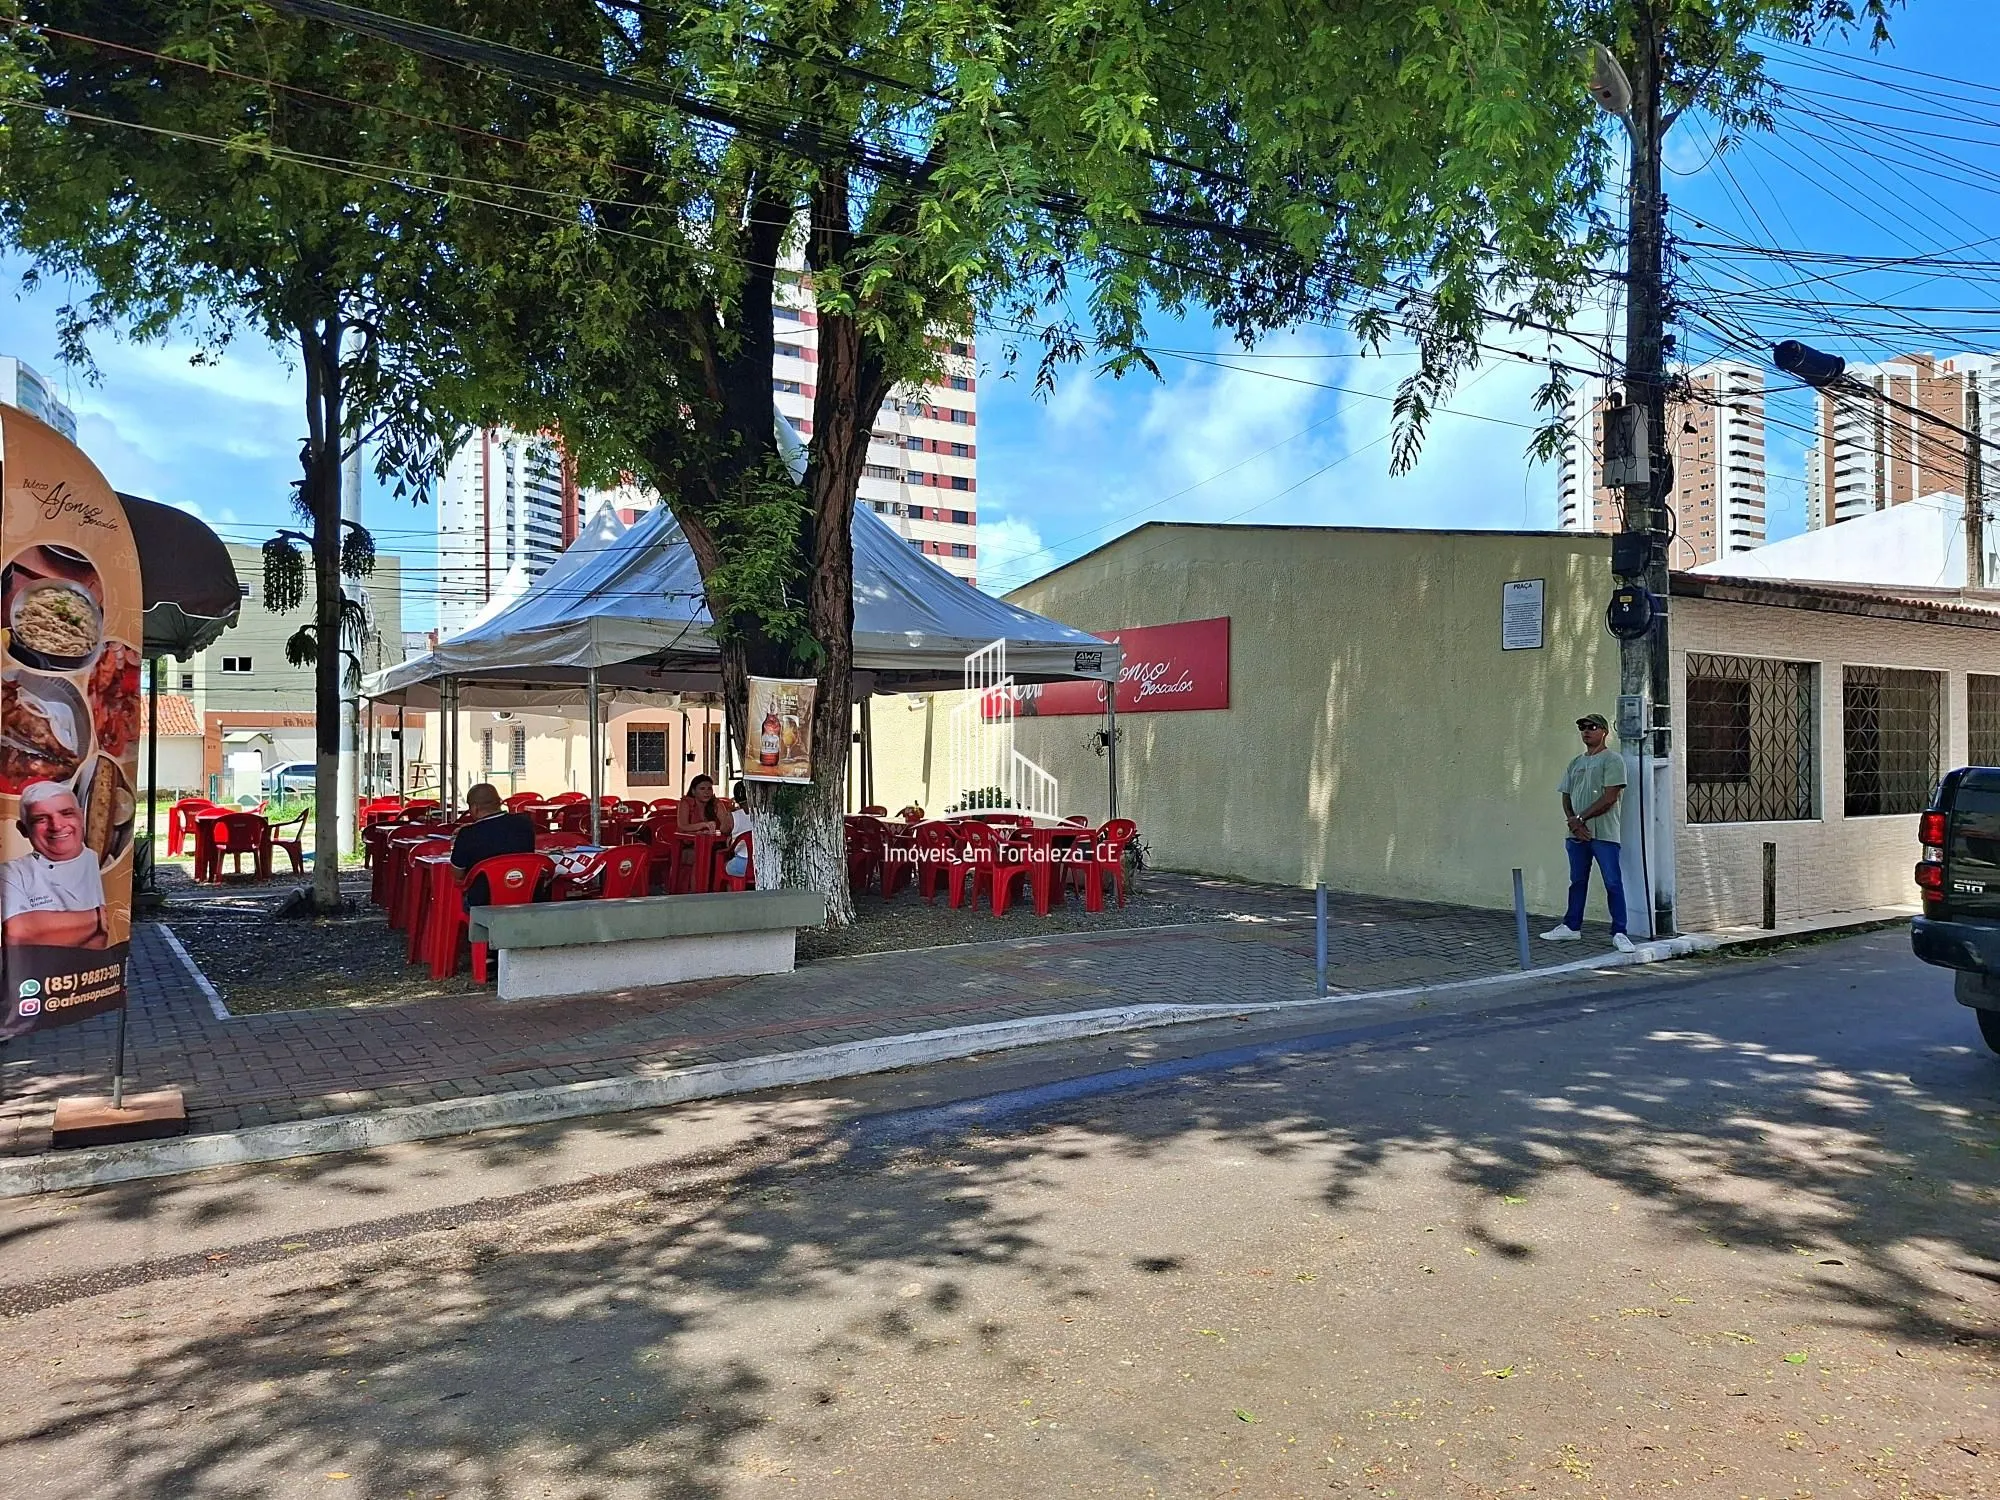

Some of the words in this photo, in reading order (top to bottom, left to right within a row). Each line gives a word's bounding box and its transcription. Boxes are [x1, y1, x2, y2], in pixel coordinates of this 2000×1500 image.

[31, 481, 103, 520] Afonso
[1513, 582, 1533, 590] PRAÇA
[1622, 603, 1630, 612] 5
[45, 973, 78, 995] (85)
